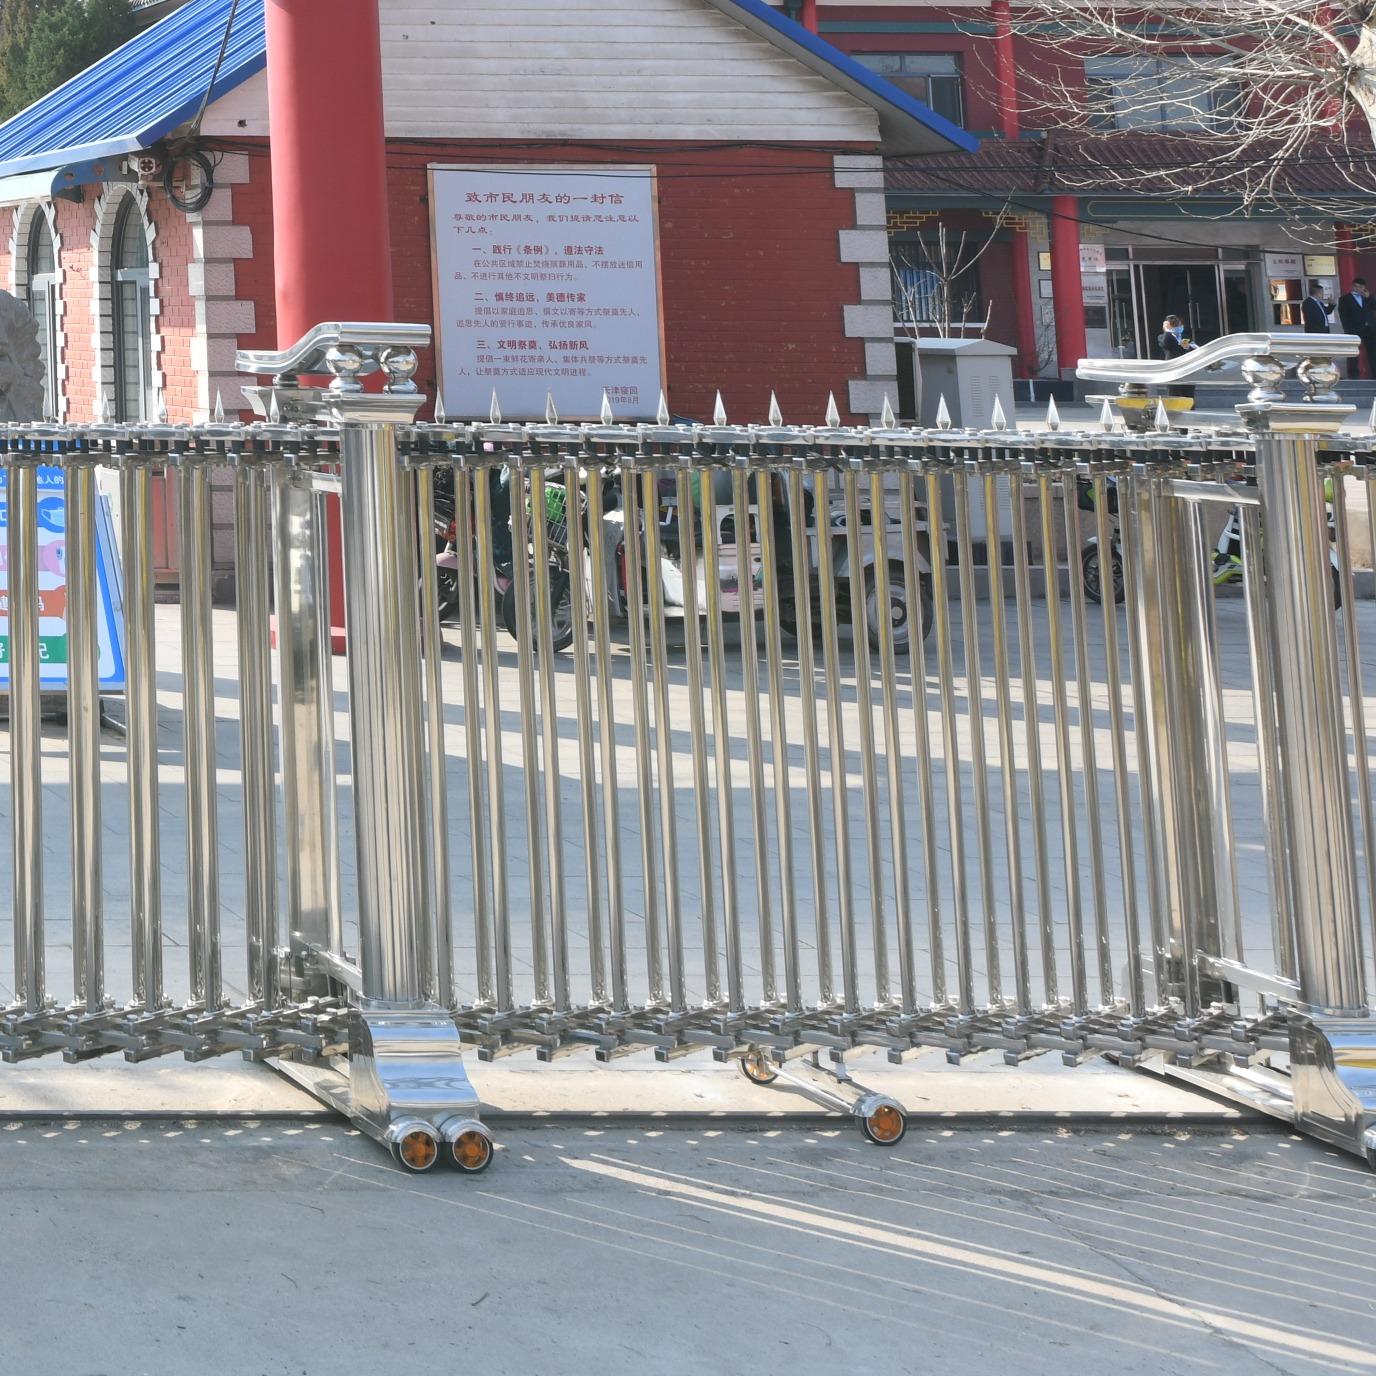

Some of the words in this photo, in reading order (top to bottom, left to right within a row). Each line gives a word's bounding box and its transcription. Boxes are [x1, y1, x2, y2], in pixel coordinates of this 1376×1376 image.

[464, 191, 625, 205] 致市民朋友的一封信
